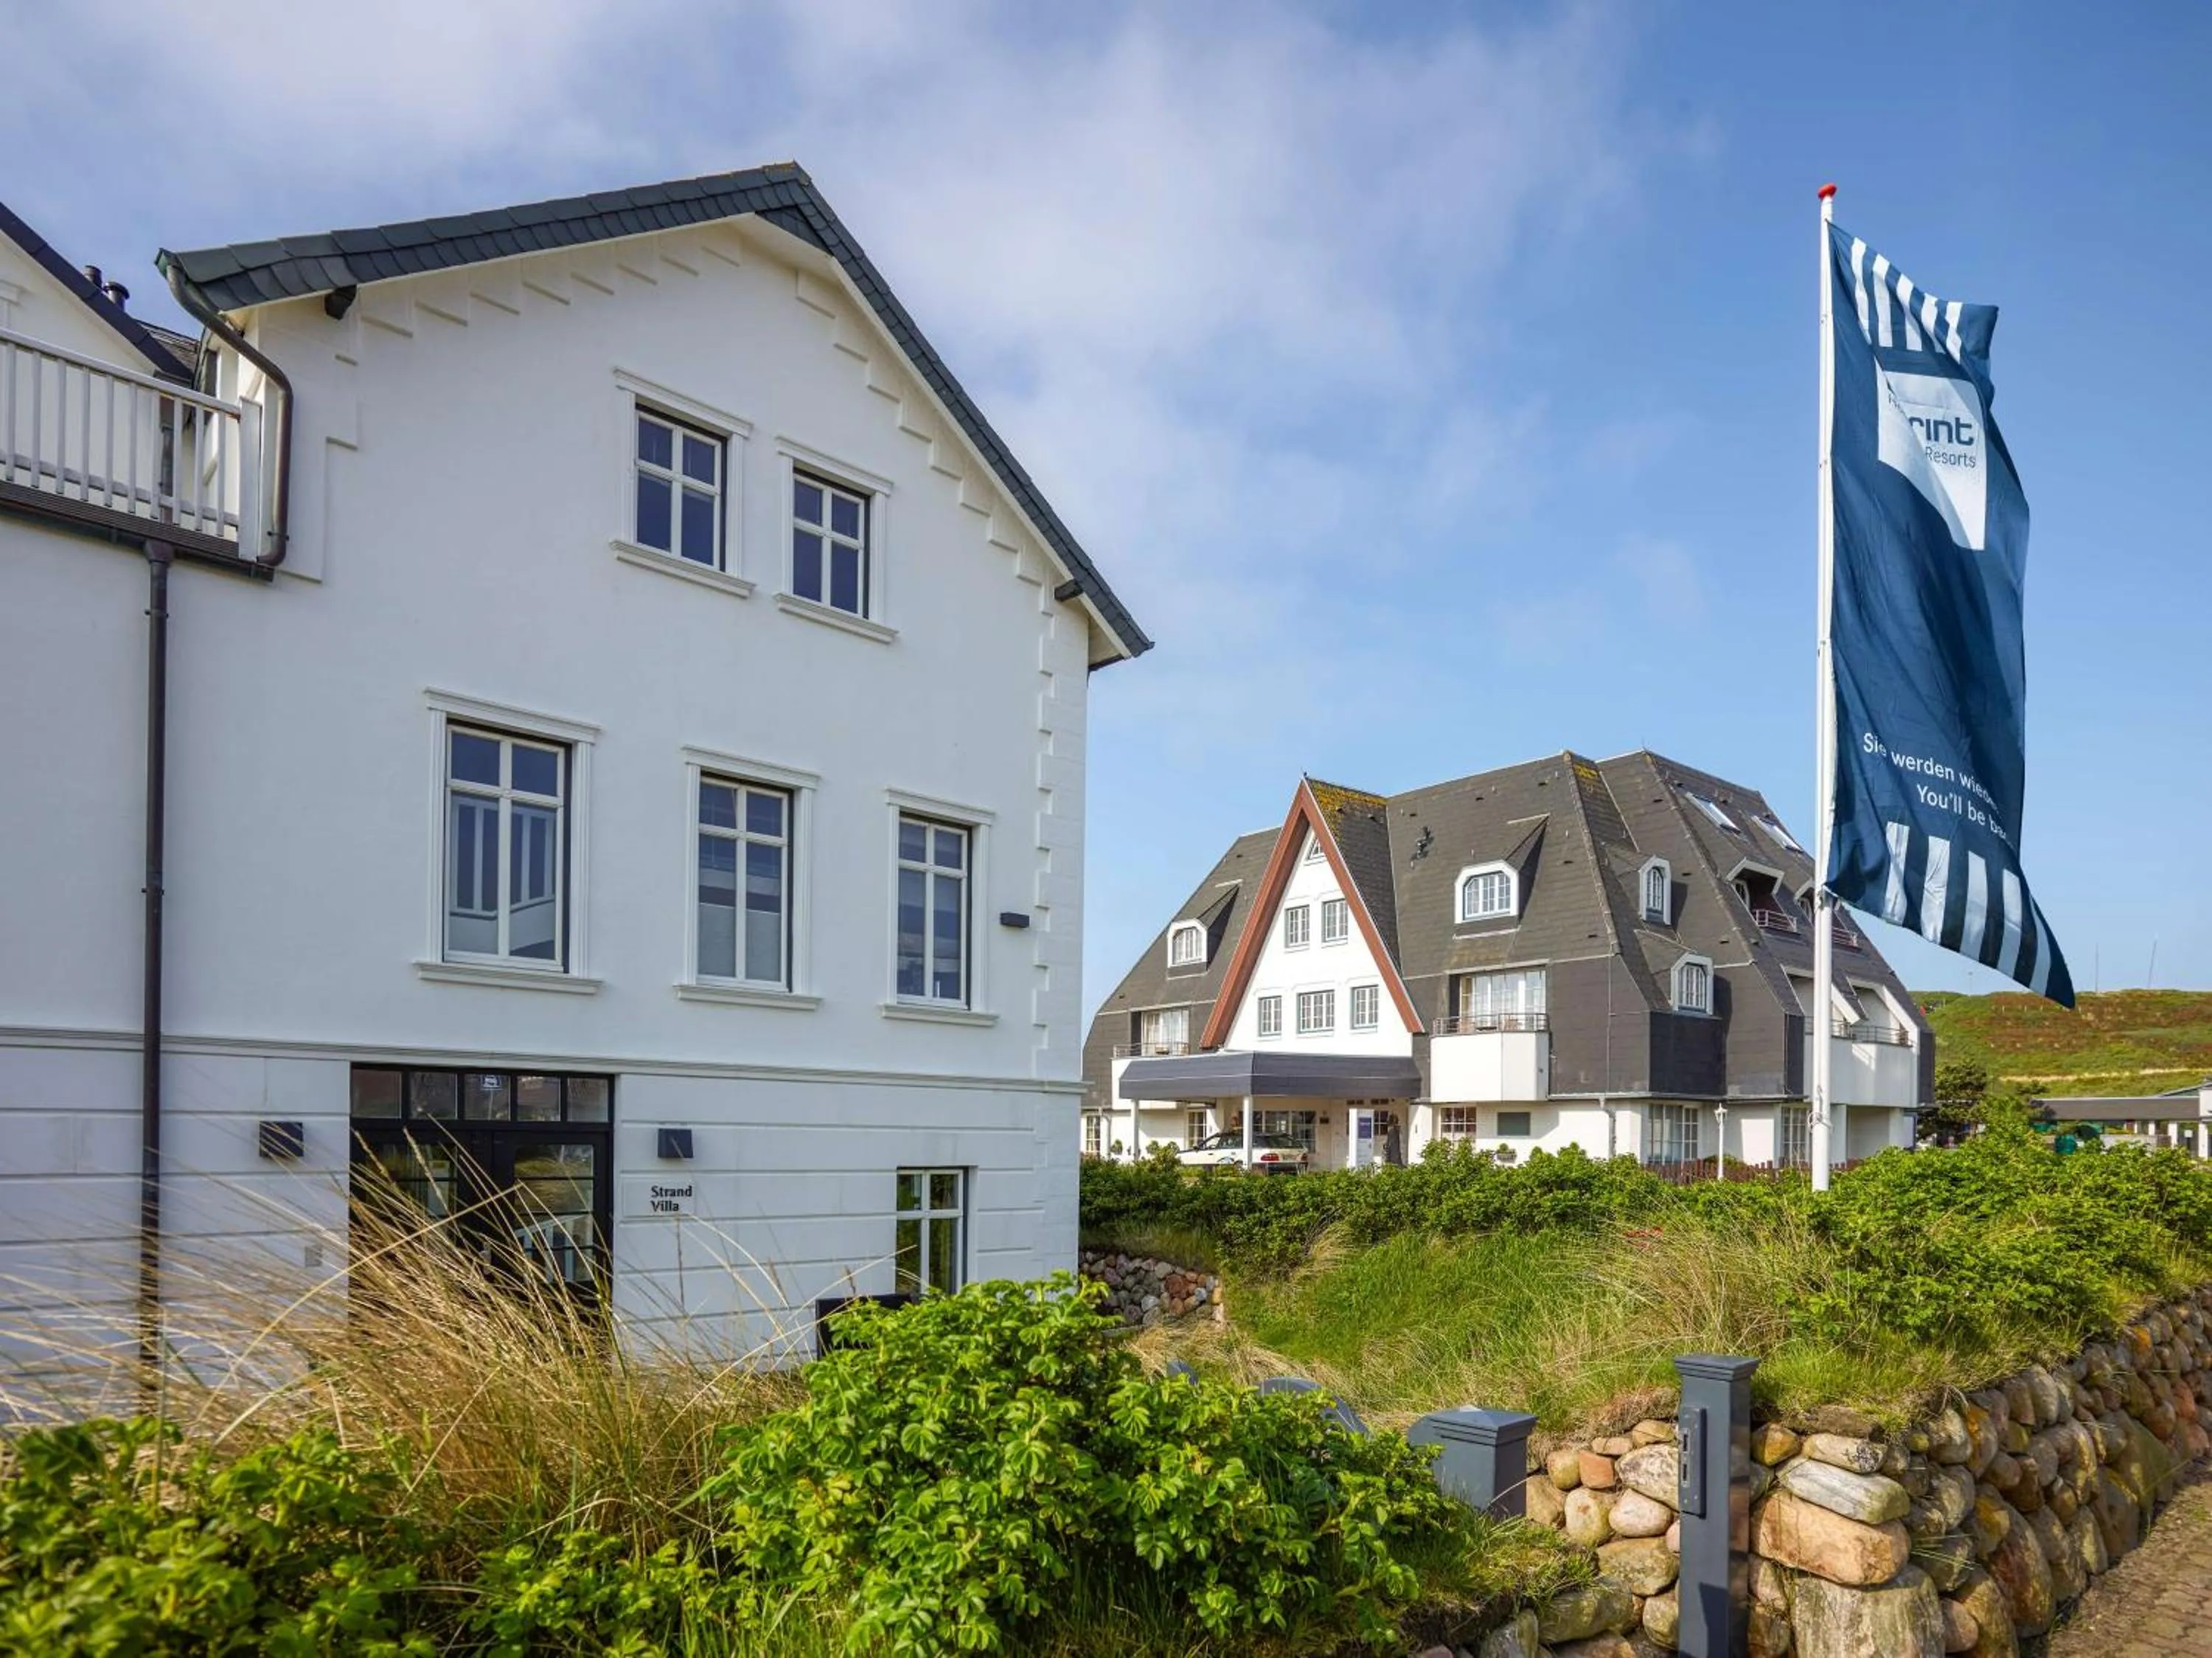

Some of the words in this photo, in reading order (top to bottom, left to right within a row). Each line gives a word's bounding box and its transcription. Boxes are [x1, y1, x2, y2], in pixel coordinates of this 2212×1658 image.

[1924, 445, 1977, 468] Resorts
[1863, 732, 1887, 757] Sie
[1891, 751, 1955, 782] werden
[1917, 784, 1962, 815] You'll
[1968, 800, 1986, 826] be
[650, 1185, 693, 1198] Strand
[650, 1200, 680, 1212] Villa
